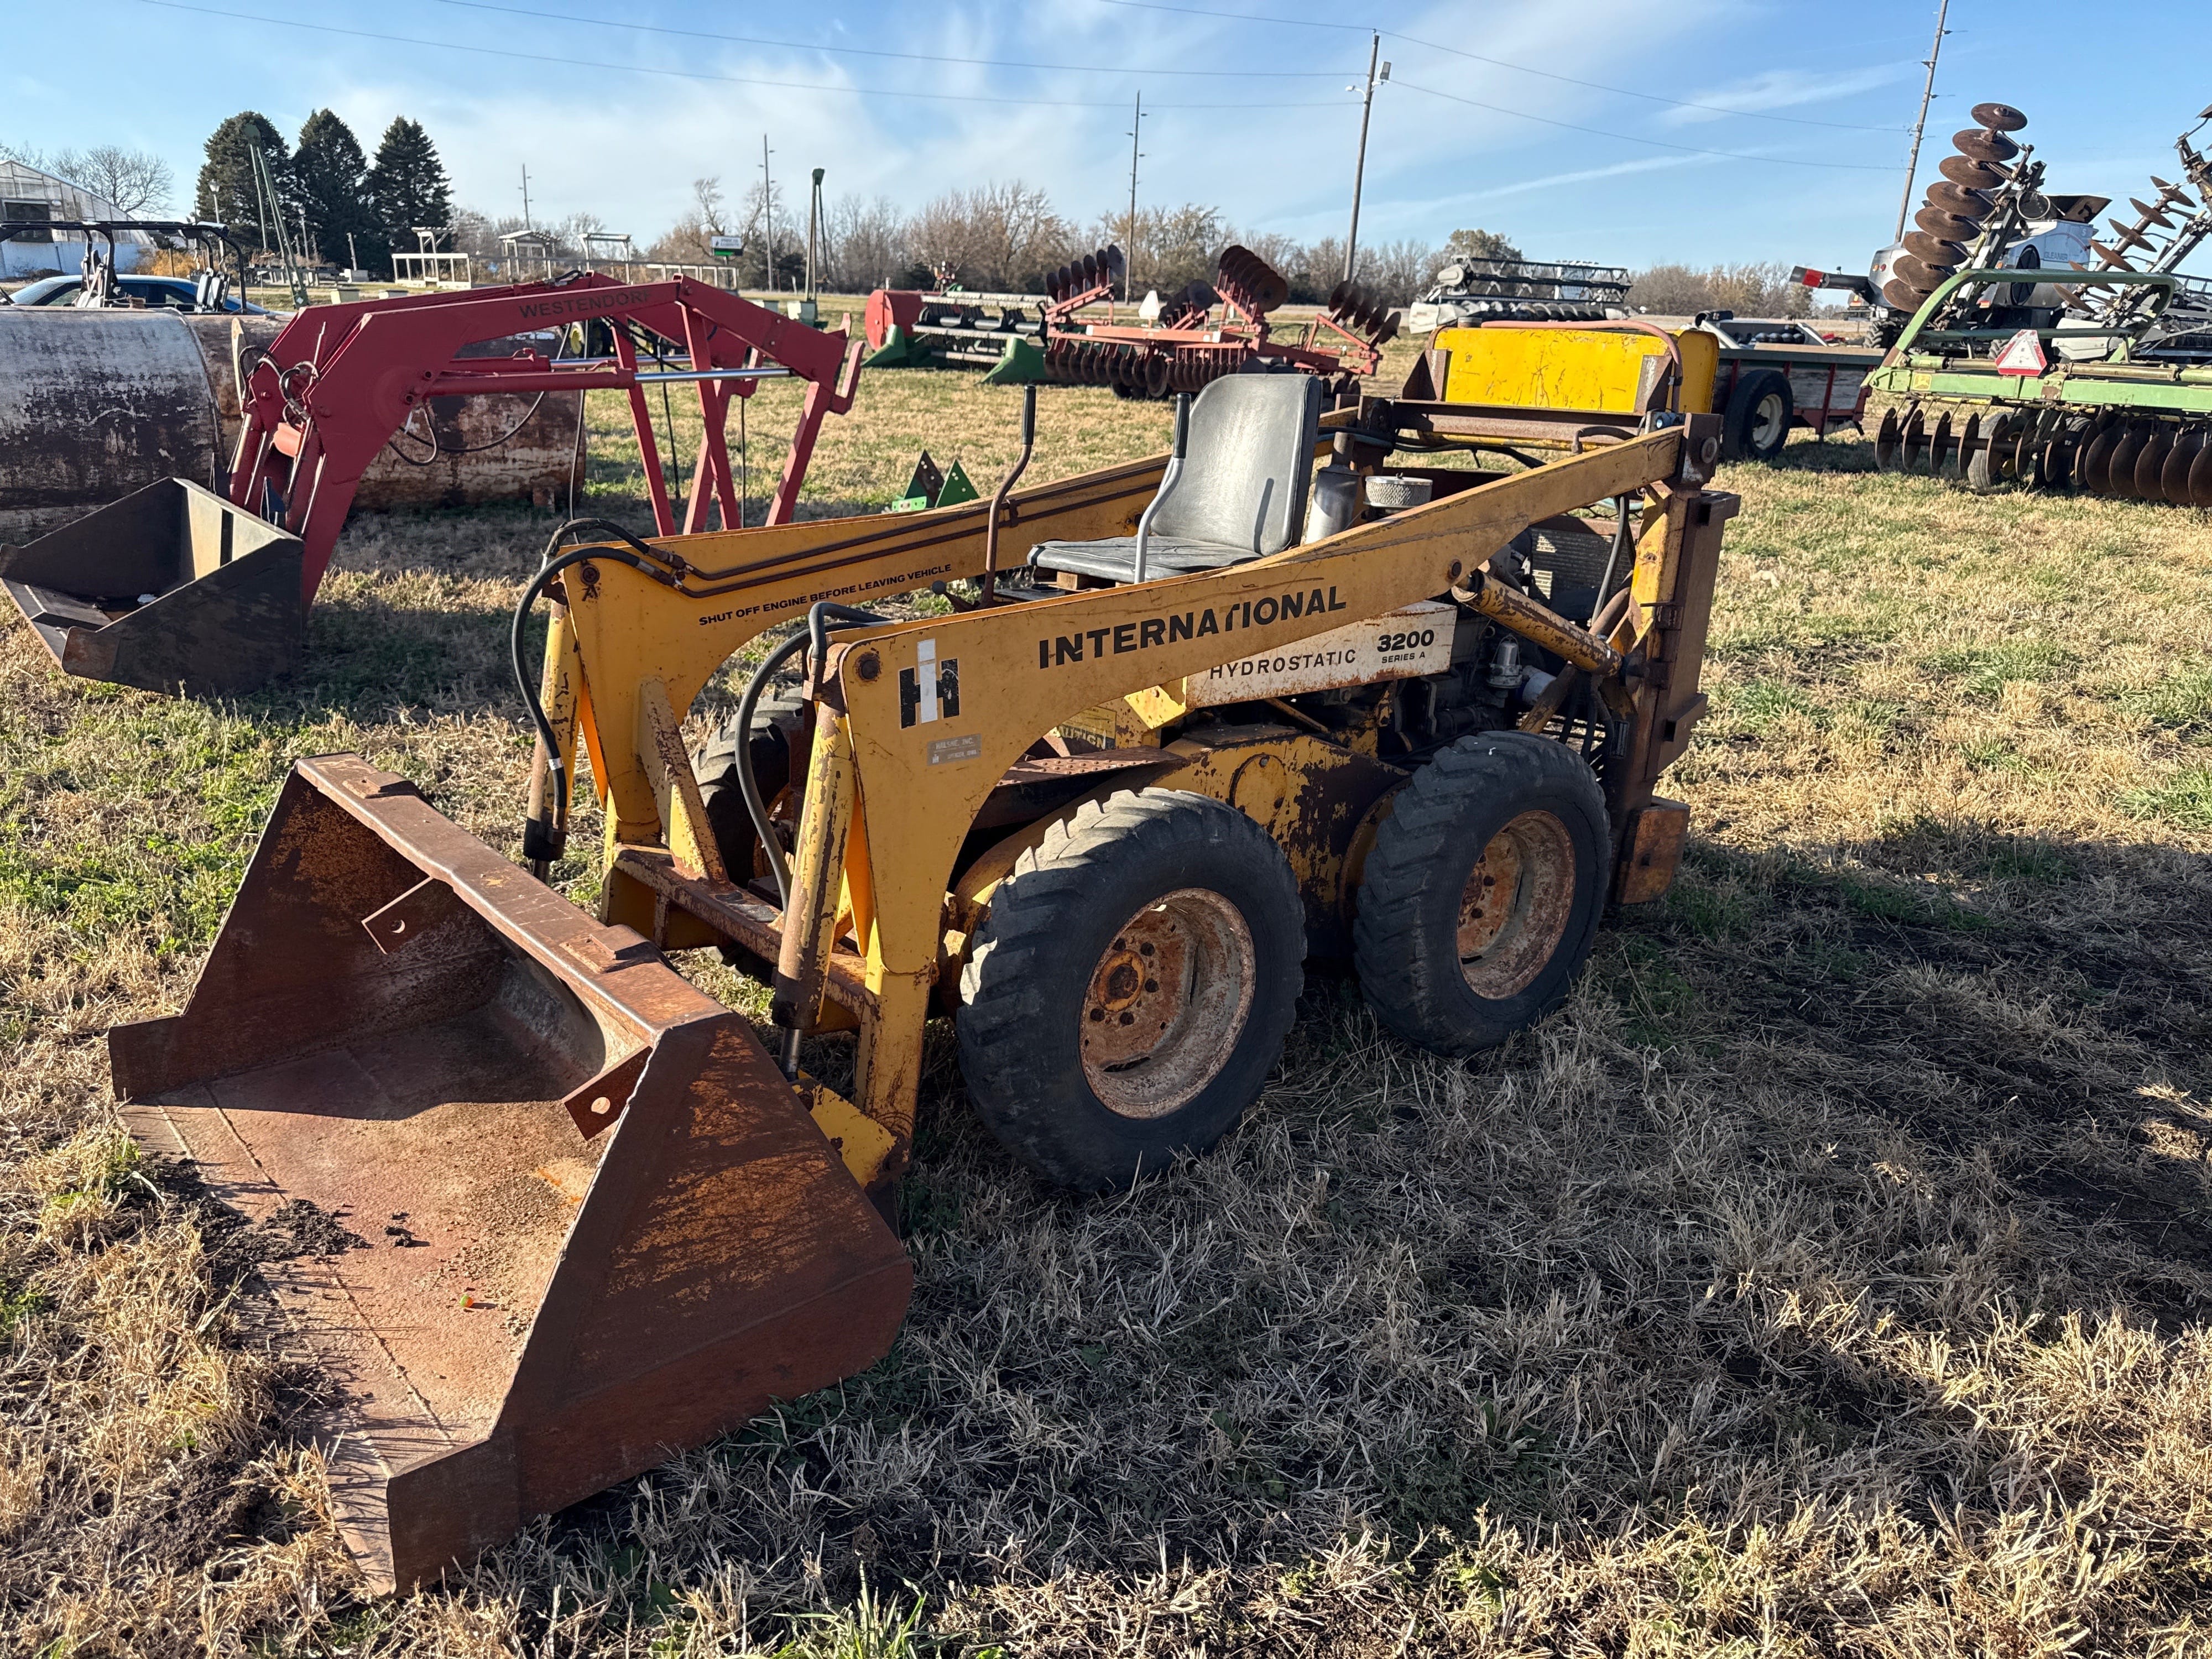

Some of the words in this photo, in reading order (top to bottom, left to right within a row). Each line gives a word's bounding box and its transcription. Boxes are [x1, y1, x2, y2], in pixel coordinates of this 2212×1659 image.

[2044, 252, 2068, 261] GLEANER
[519, 289, 650, 319] WESTENDORF
[699, 611, 733, 626] SHUT
[735, 606, 760, 618] OFF
[763, 596, 807, 612] ENGINE
[810, 585, 857, 602] BEFORE
[858, 574, 906, 592] LEAVING
[906, 564, 952, 581] VEHICLE
[1039, 586, 1347, 669] INTERNATIONAL
[1376, 629, 1435, 653] 3200
[1209, 649, 1357, 680] HYDROSTATIC
[1381, 653, 1416, 664] SERIES
